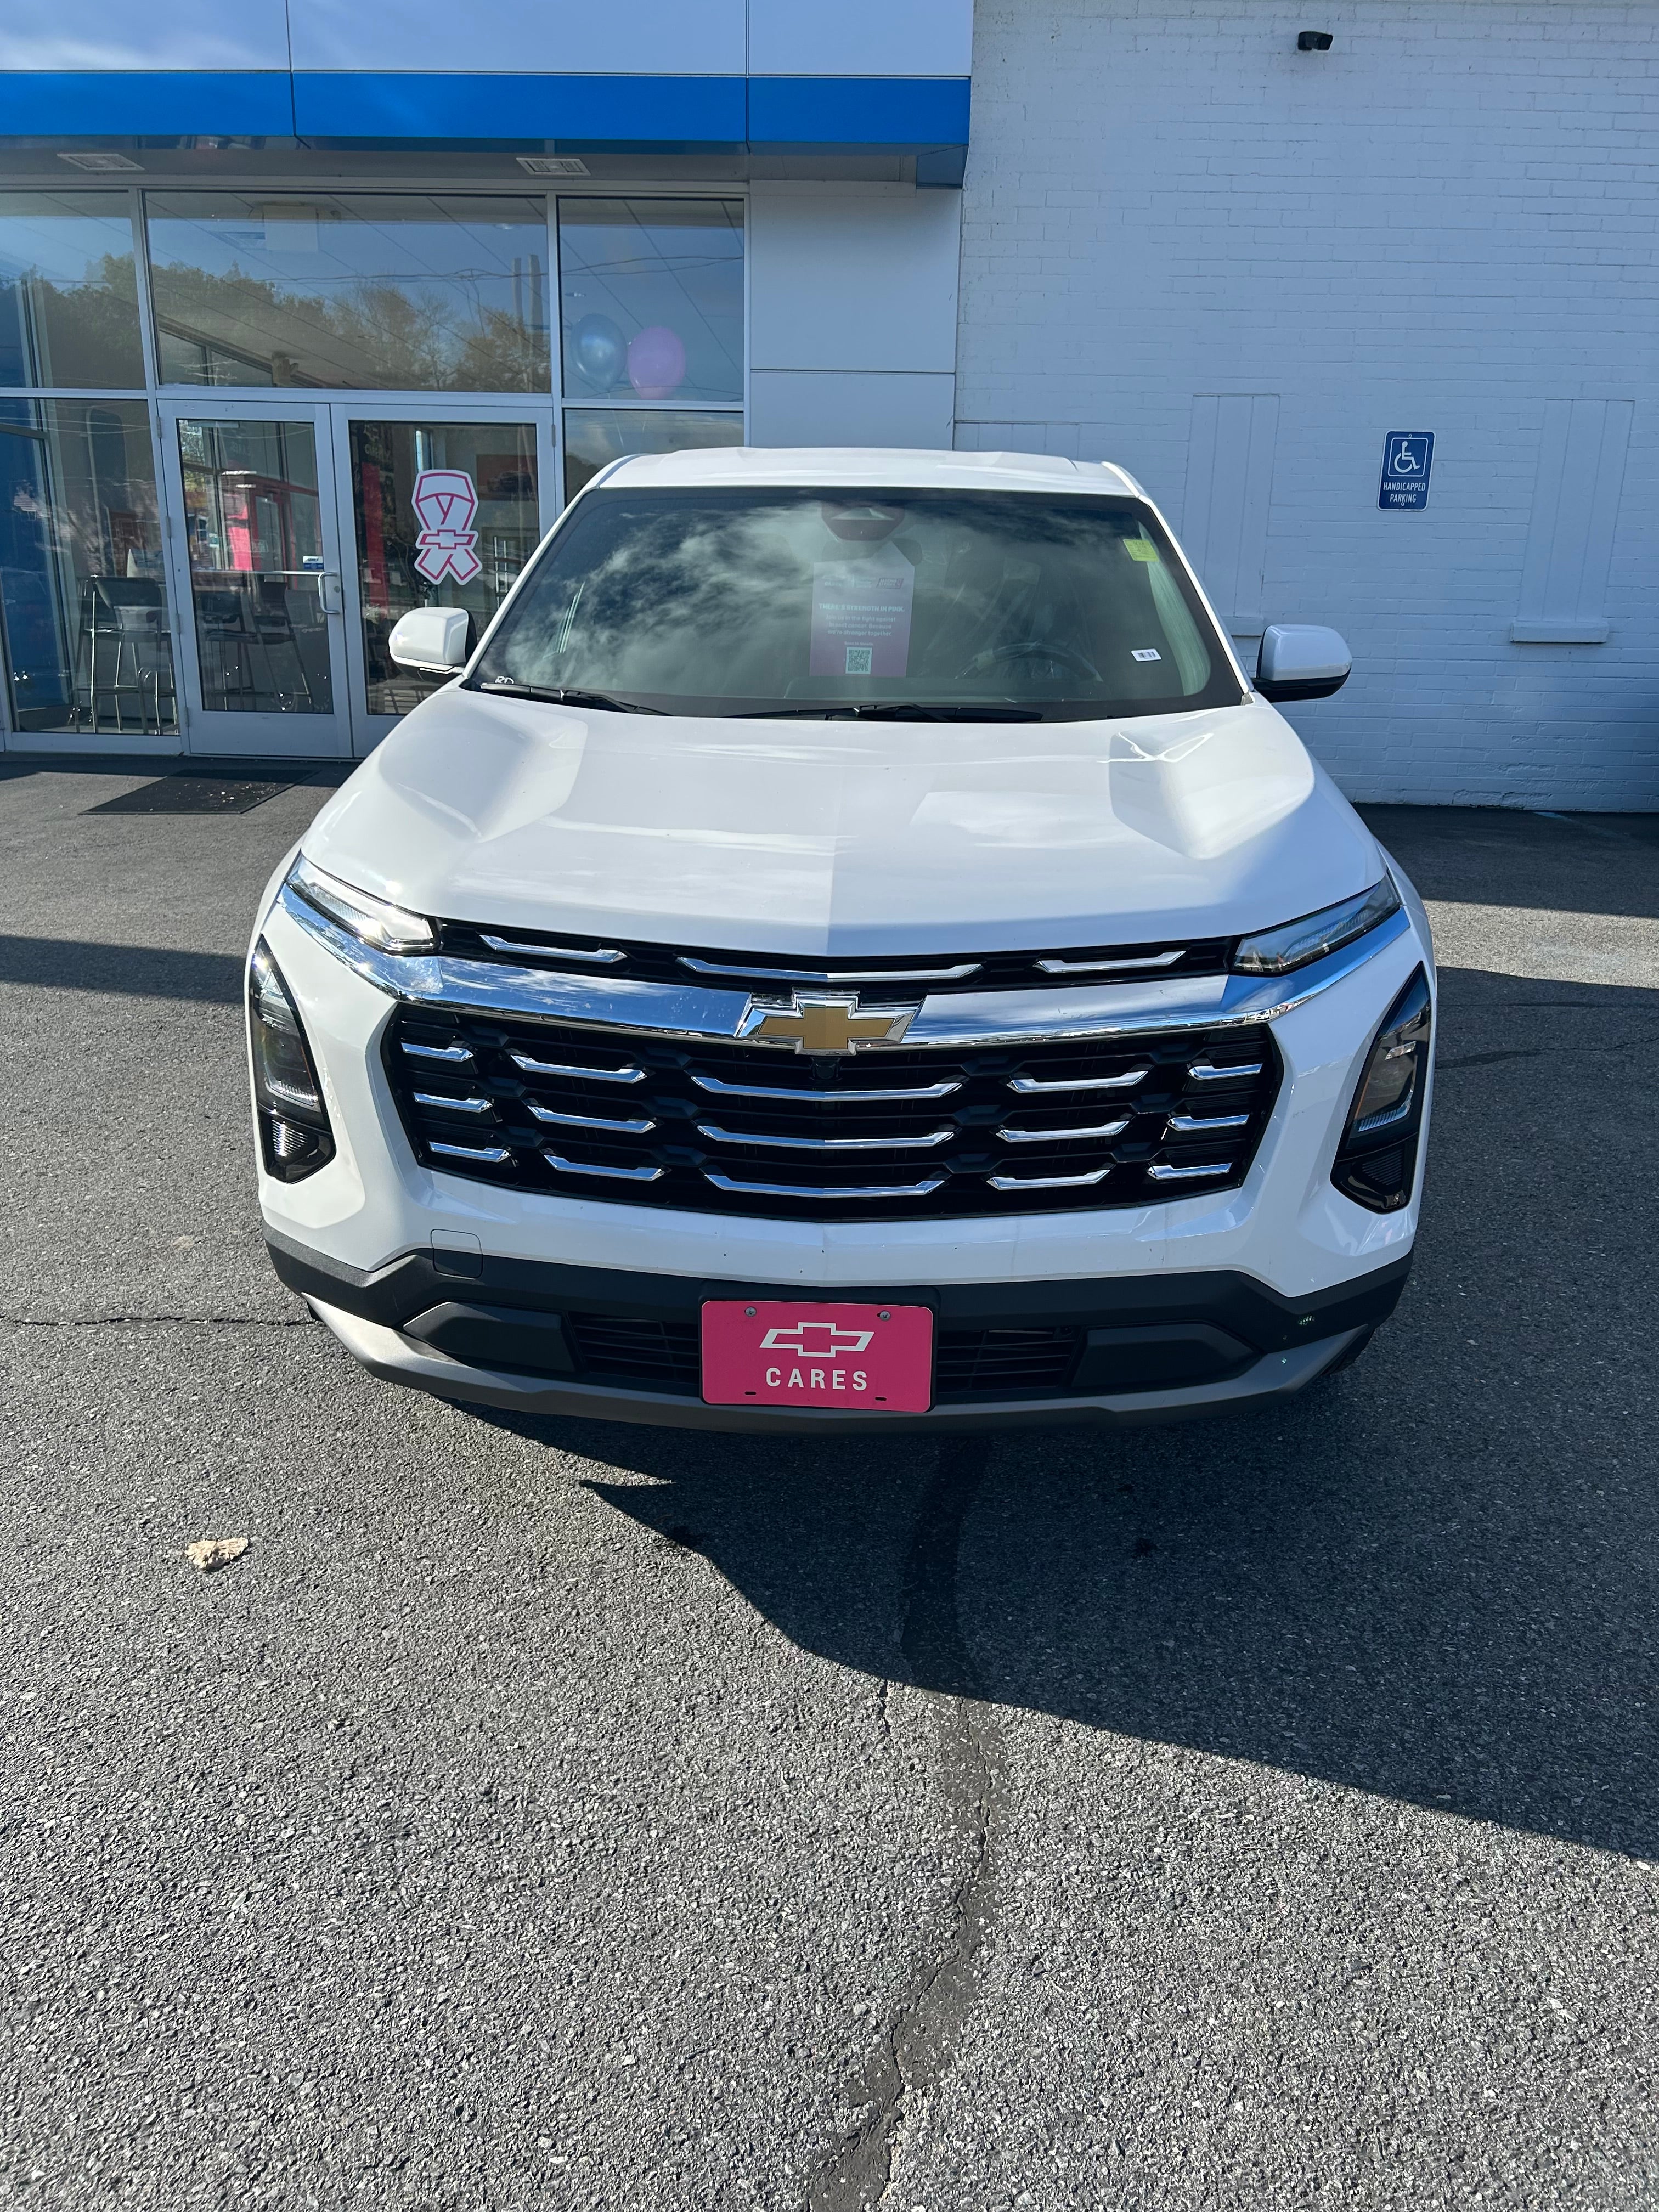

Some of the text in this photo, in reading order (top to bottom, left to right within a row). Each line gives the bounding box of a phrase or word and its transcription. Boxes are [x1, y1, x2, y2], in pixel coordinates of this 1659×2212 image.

[1383, 482, 1426, 492] HANDICAPPED
[1390, 493, 1417, 503] PARKING
[766, 1367, 867, 1391] CARES
